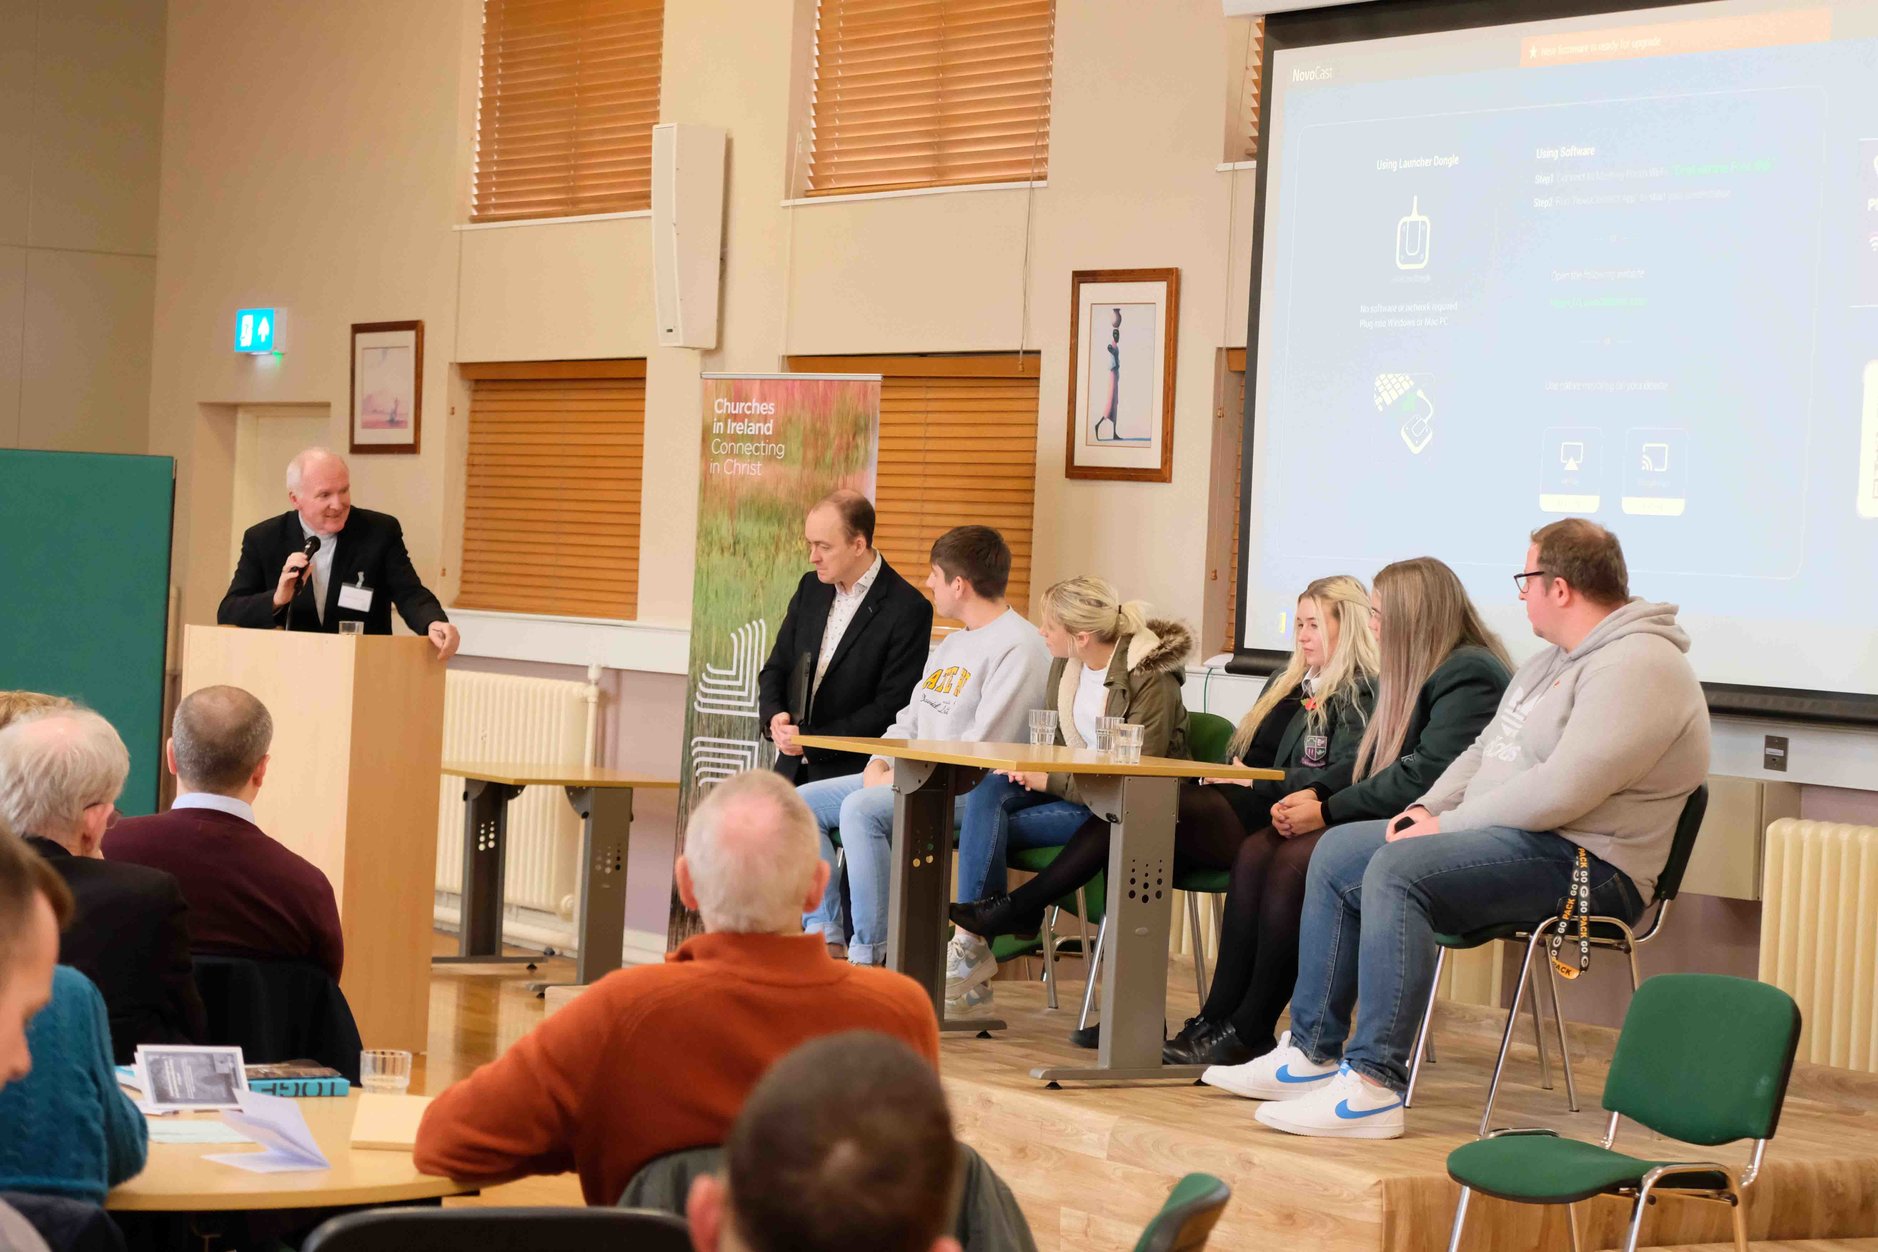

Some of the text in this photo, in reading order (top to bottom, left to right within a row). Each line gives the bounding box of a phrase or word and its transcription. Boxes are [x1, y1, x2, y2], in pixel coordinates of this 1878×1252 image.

[1536, 145, 1596, 160] Using Software
[1376, 154, 1459, 172] Using Launcher Dongle
[714, 398, 775, 415] Churches
[712, 418, 774, 436] in Ireland
[711, 438, 785, 459] Connecting
[709, 458, 762, 476] in Christ
[1580, 870, 1588, 883] GO
[1579, 885, 1589, 898] G
[1580, 900, 1589, 913] GO
[1552, 936, 1562, 948] G
[1557, 921, 1567, 934] GO
[1562, 898, 1576, 920] PACK
[1570, 883, 1579, 896] GO
[1579, 915, 1589, 938] PACK
[1580, 940, 1589, 953] GO
